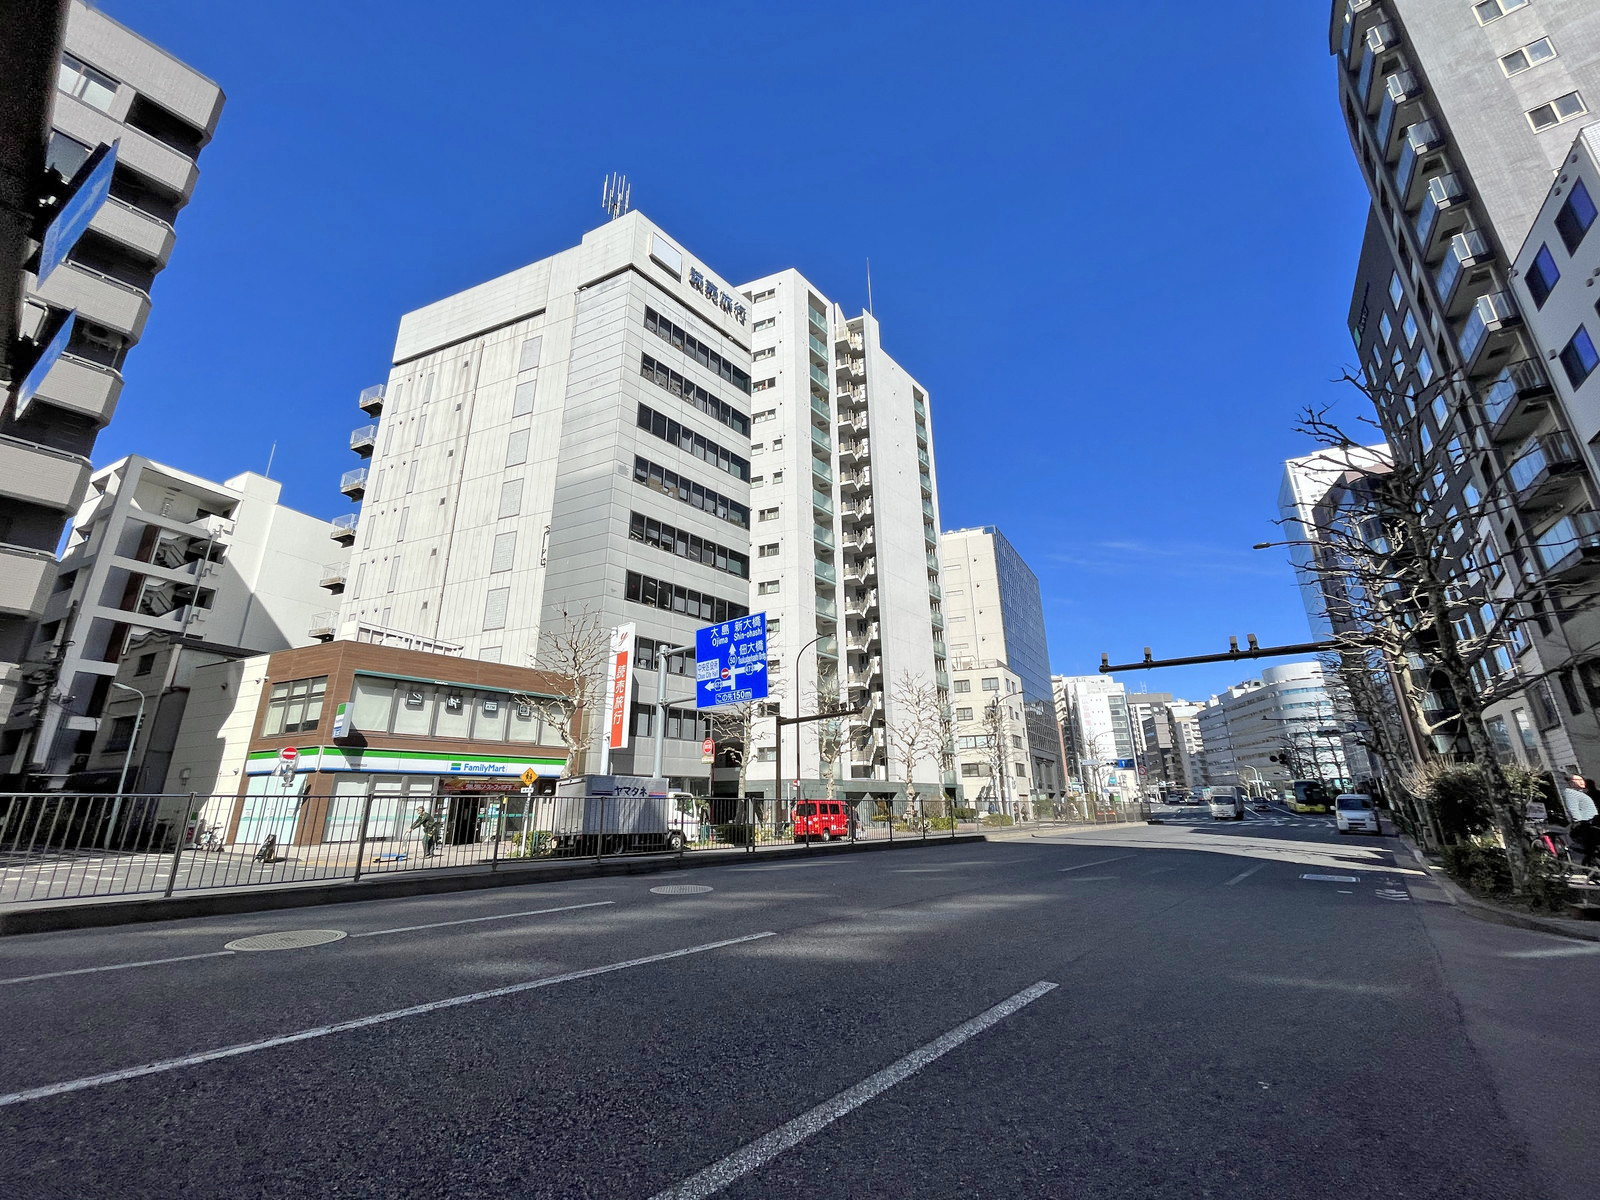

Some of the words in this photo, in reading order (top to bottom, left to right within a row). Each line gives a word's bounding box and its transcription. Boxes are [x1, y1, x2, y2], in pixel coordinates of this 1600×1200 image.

[711, 624, 730, 639] 大島
[734, 616, 761, 631] 新大橋
[712, 637, 728, 647] Ojima
[734, 627, 762, 641] Shin-ohashi
[740, 640, 764, 655] 佃大橋
[613, 665, 625, 724] 読売旅行
[463, 763, 506, 773] FamilyMart
[614, 785, 648, 797] ヤマタネ
